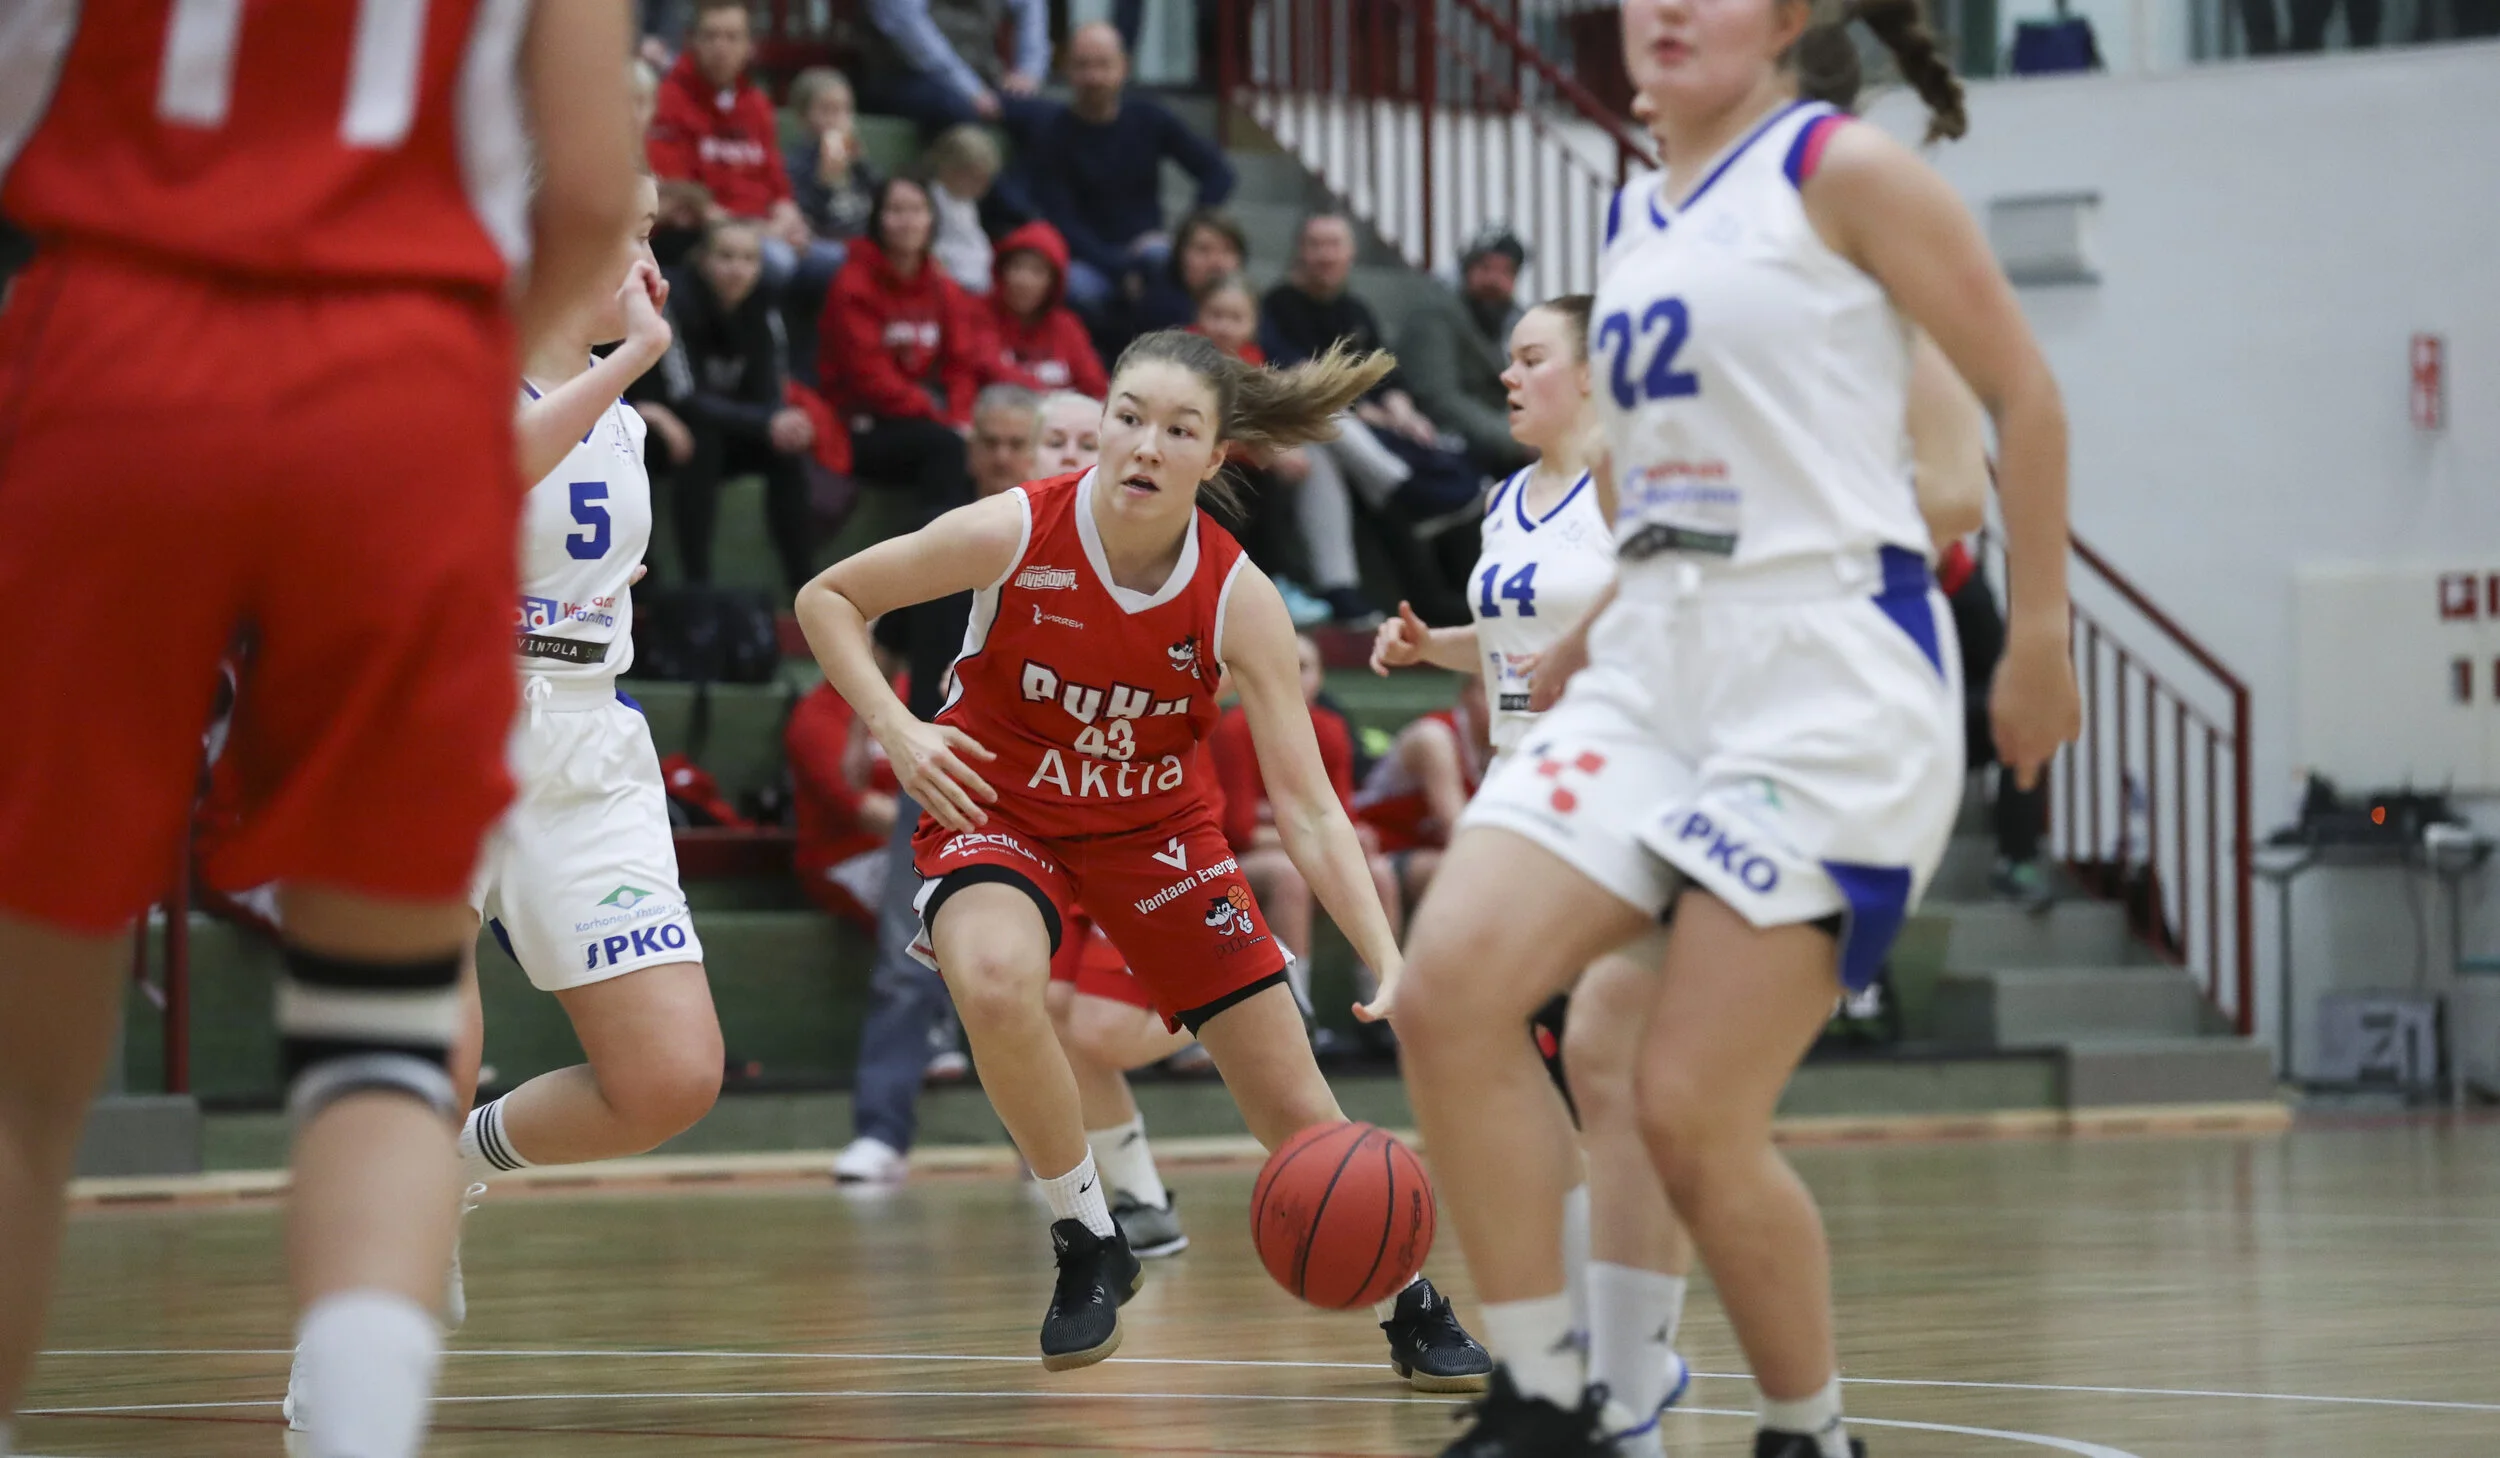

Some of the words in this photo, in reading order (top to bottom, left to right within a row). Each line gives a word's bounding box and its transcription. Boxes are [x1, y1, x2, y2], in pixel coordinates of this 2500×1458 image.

[1598, 296, 1699, 412] 22
[565, 481, 611, 560] 5
[1479, 562, 1538, 617] 14
[517, 638, 578, 657] VINTOLA
[1073, 718, 1136, 761] 43
[1027, 748, 1183, 798] Aktia
[1134, 876, 1198, 915] Vantaan
[1196, 856, 1239, 883] Energia
